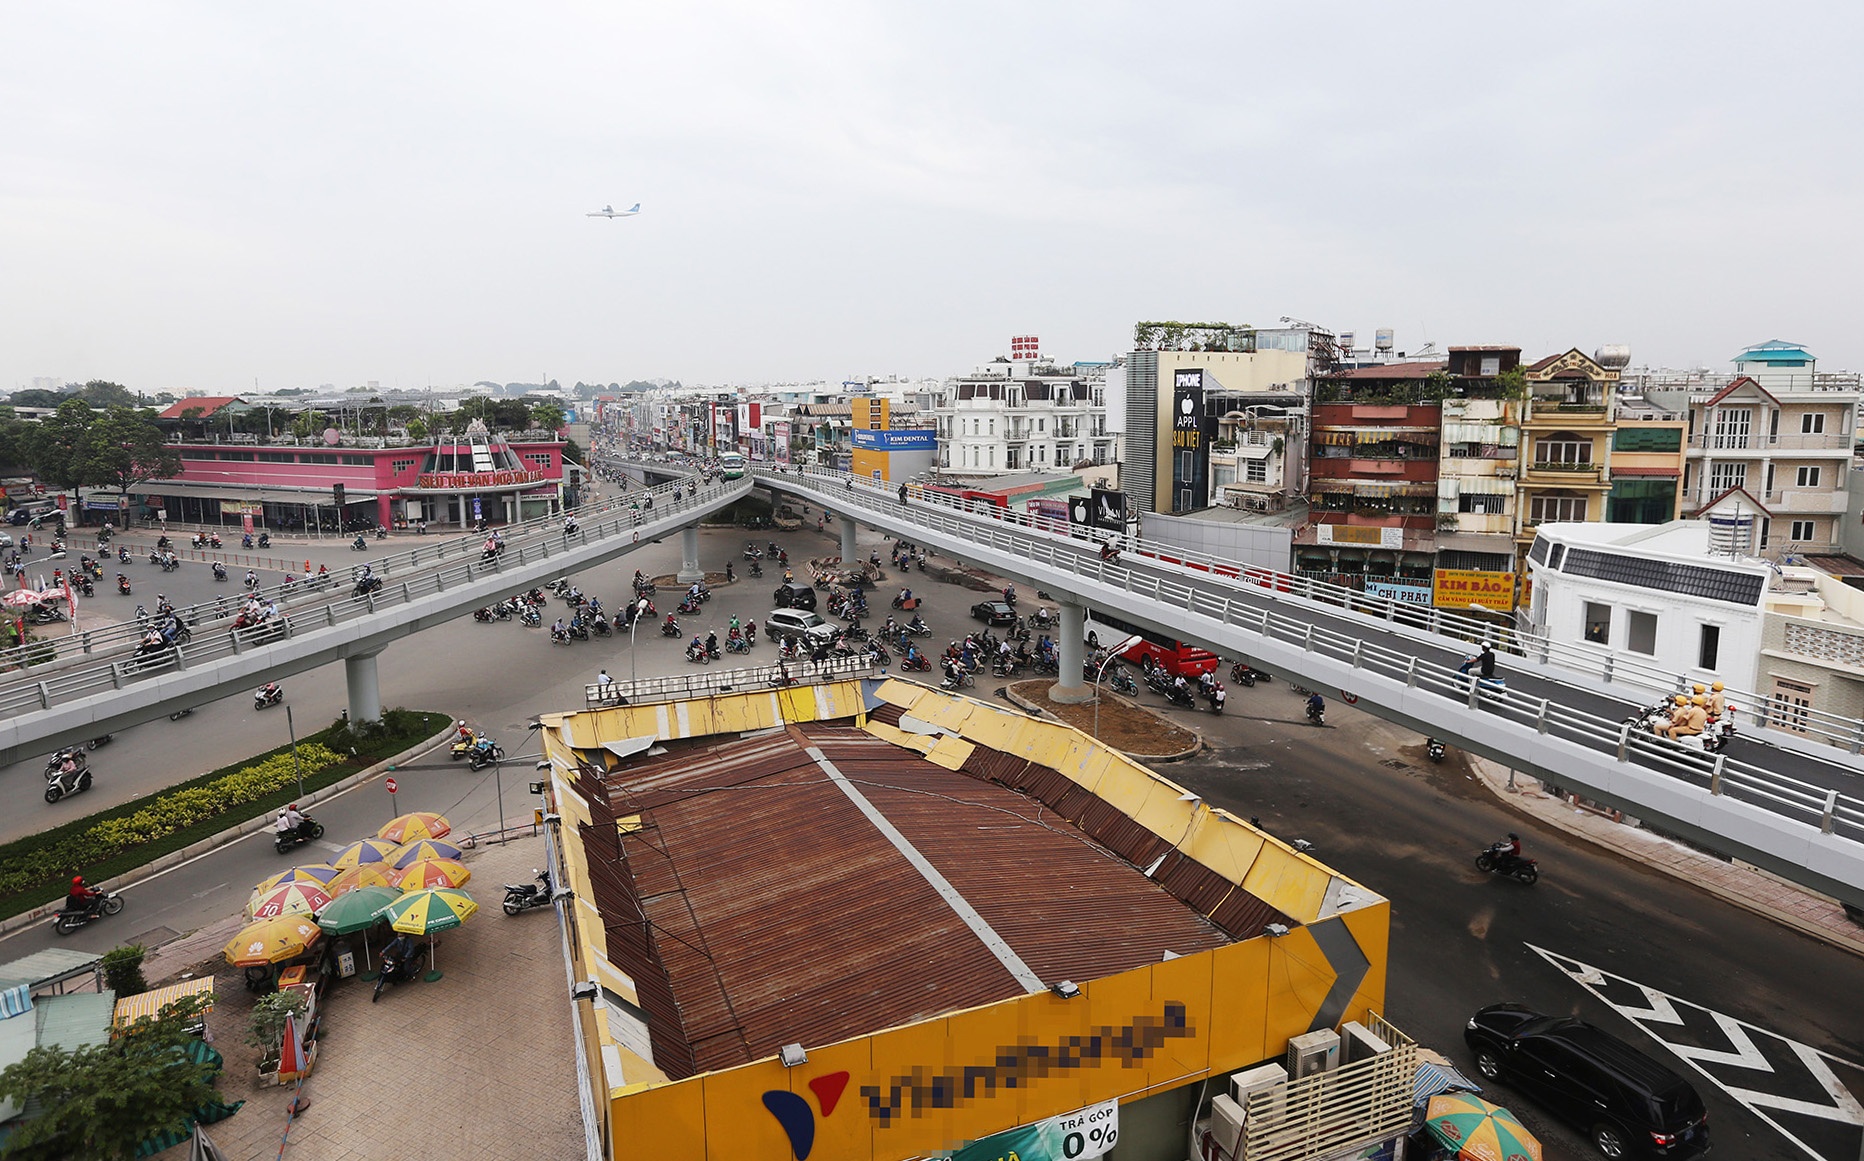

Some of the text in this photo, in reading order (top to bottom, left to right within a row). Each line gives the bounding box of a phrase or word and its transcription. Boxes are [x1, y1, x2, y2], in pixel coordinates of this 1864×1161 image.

[1176, 374, 1200, 387] IPHONE
[1439, 580, 1468, 590] KIM
[1470, 578, 1501, 592] BẢO
[1378, 587, 1397, 600] CHÍ
[1400, 590, 1428, 602] PHÁT
[262, 904, 279, 917] 10
[1060, 1108, 1113, 1130] TRẢ GÓP
